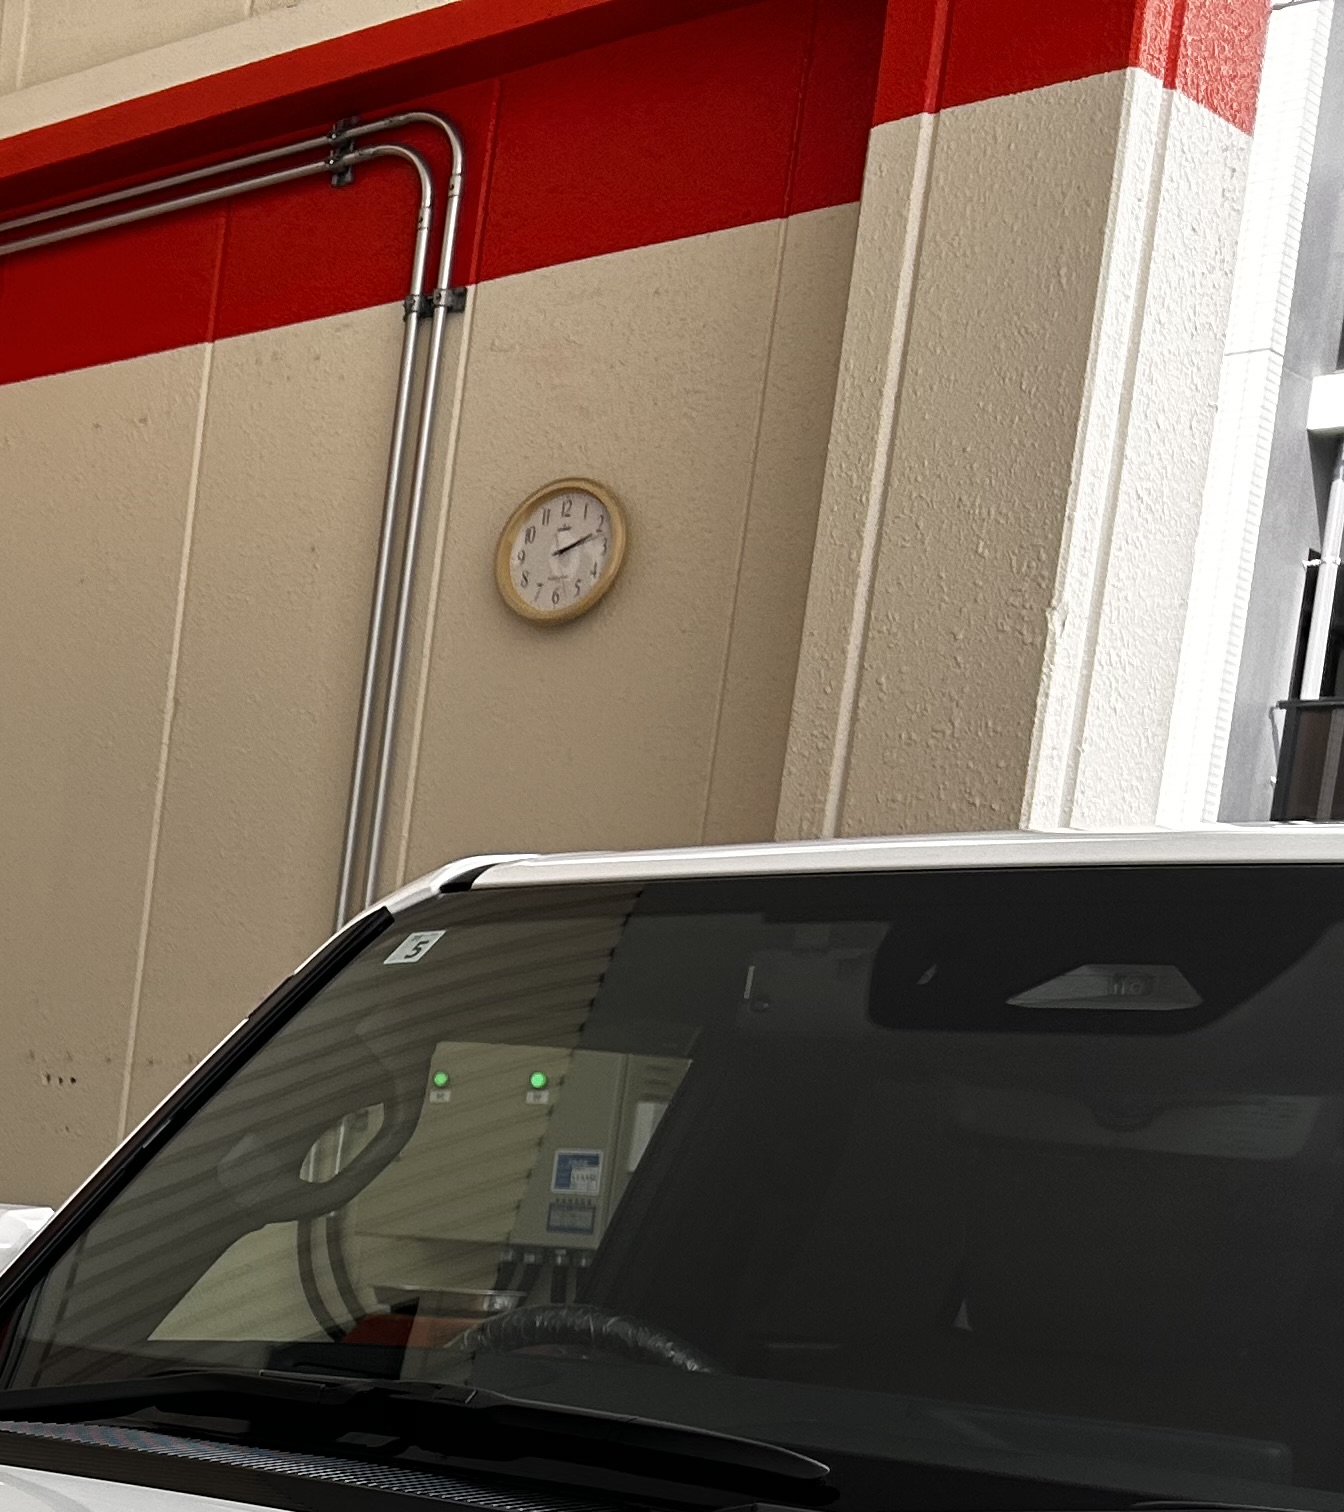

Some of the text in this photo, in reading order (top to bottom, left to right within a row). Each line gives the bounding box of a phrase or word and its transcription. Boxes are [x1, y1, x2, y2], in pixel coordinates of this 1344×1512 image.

[541, 507, 551, 526] 11
[562, 499, 572, 518] 12
[583, 503, 588, 520] 1
[596, 515, 605, 533] 2
[525, 525, 536, 545] 10
[517, 550, 526, 566] 9
[520, 570, 529, 589] 8
[574, 579, 582, 597] 5
[534, 582, 544, 602] 7
[552, 587, 560, 605] 6
[404, 940, 429, 959] 5
